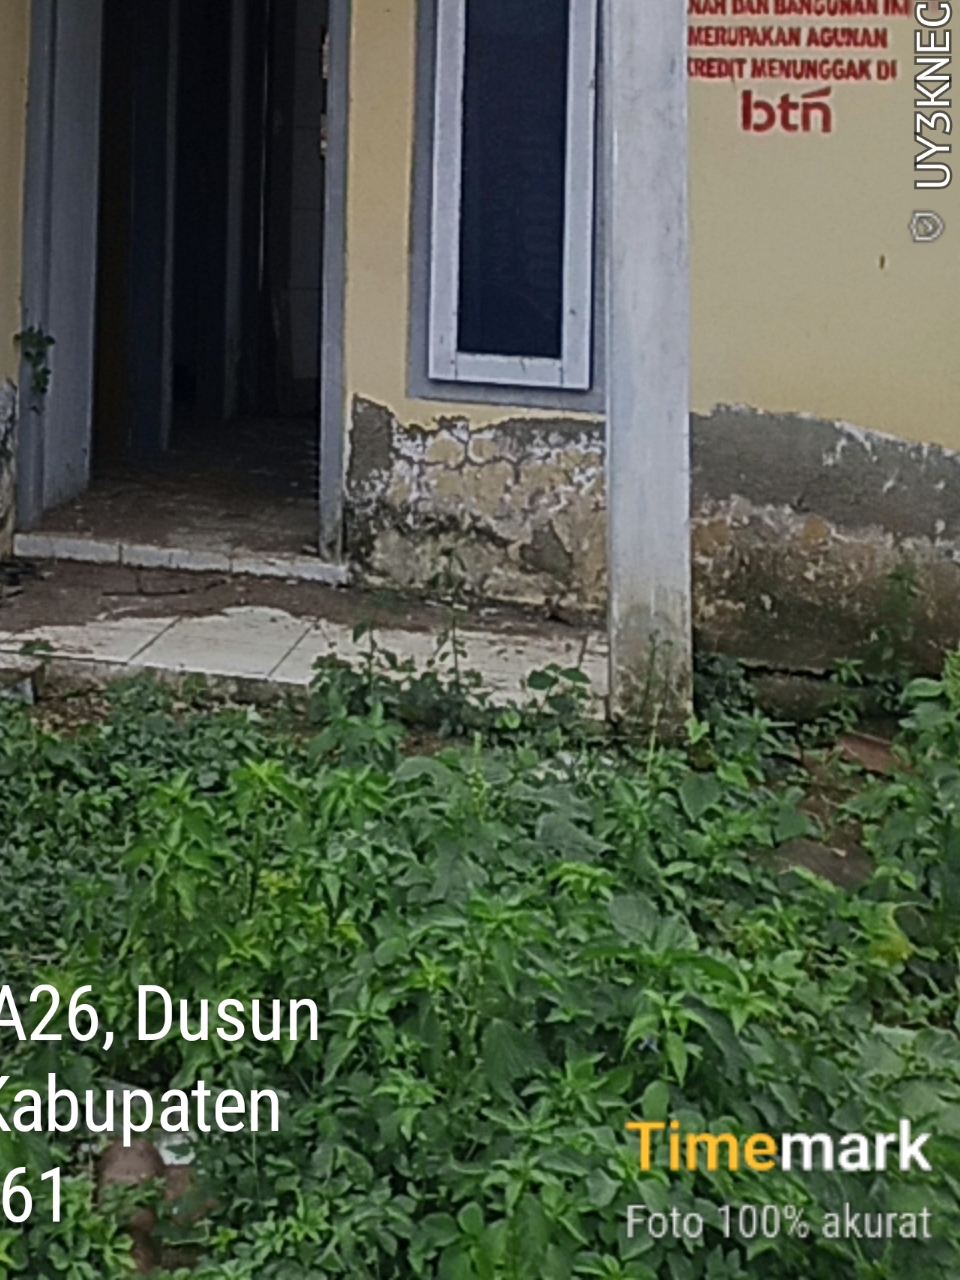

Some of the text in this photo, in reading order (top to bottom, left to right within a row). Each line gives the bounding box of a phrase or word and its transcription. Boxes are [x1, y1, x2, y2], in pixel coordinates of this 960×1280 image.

[688, 25, 888, 49] MERUPAKAN AGUNAN
[751, 58, 872, 80] MENUNGGAK
[876, 59, 898, 81] DI
